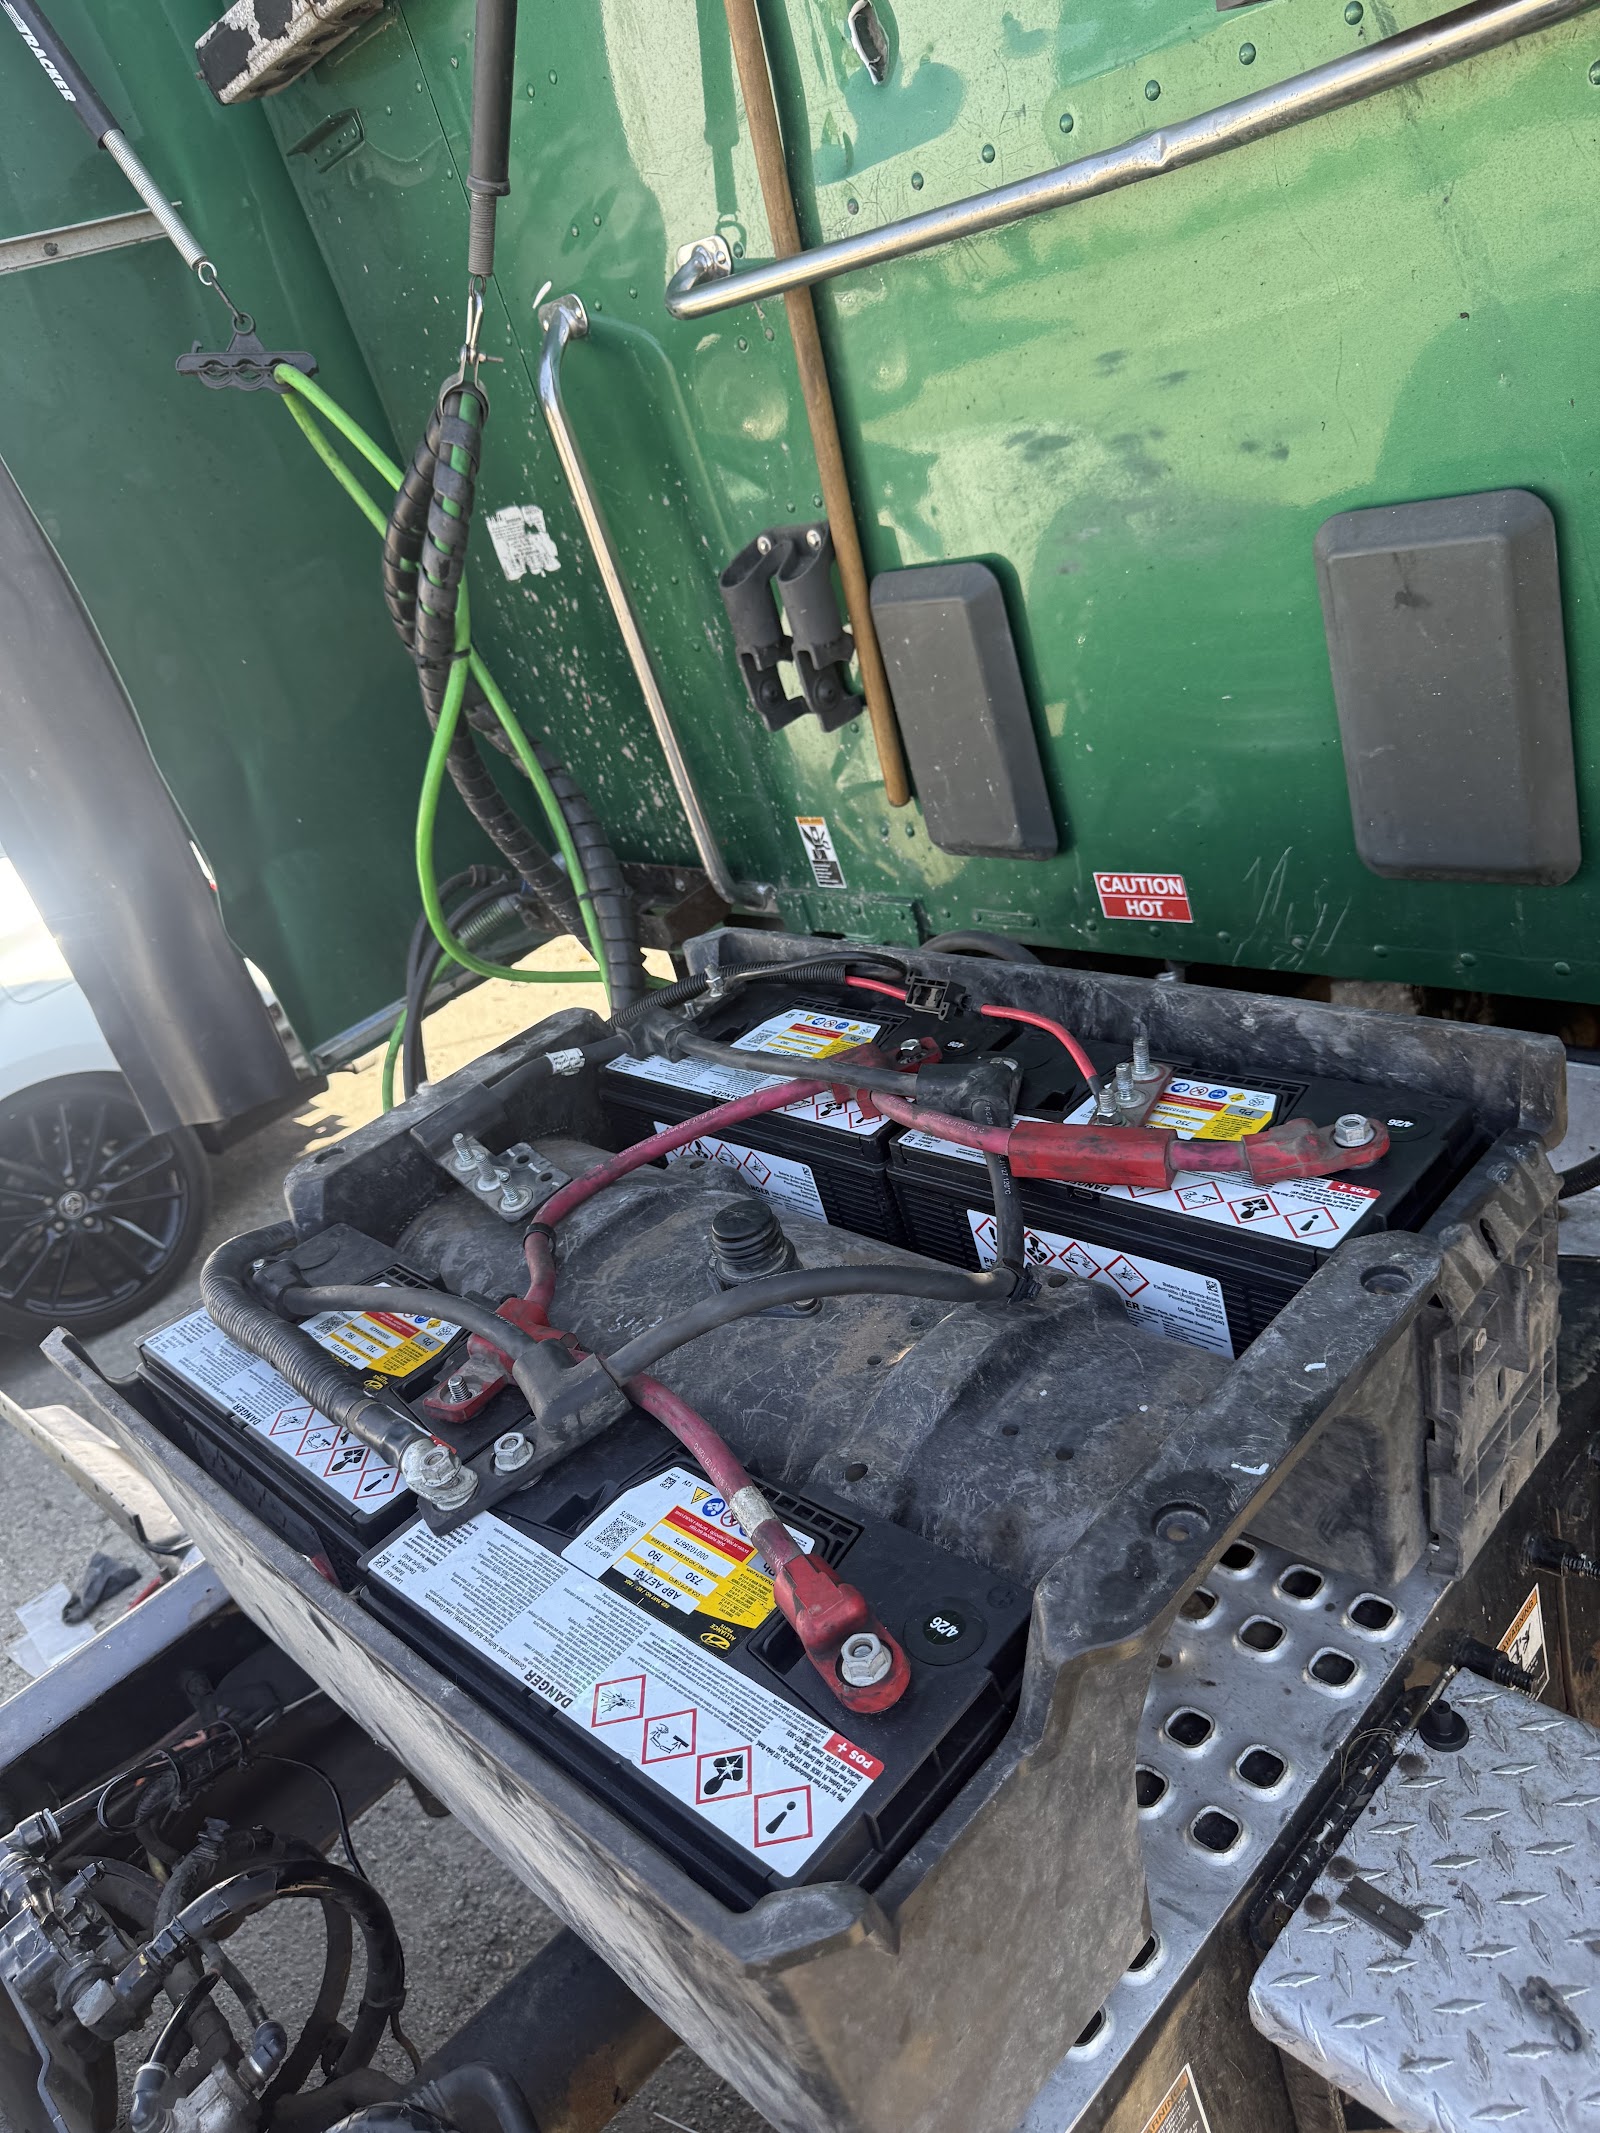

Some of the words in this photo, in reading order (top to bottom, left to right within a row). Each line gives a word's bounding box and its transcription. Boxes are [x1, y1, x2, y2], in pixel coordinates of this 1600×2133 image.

[19, 24, 76, 102] TRACKER
[1100, 876, 1183, 895] CAUTION
[1125, 900, 1163, 916] HOT
[1348, 1186, 1371, 1194] POS
[419, 1336, 435, 1347] Pb
[231, 1402, 262, 1425] DANGER
[646, 1549, 664, 1562] 190
[683, 1571, 703, 1586] 730
[660, 1584, 682, 1601] ABP
[708, 1621, 737, 1642] ALLIANCE
[930, 1617, 959, 1638] 4/26
[1504, 1599, 1534, 1646] WARNING
[521, 1668, 574, 1709] DANGER
[846, 1748, 874, 1770] POS
